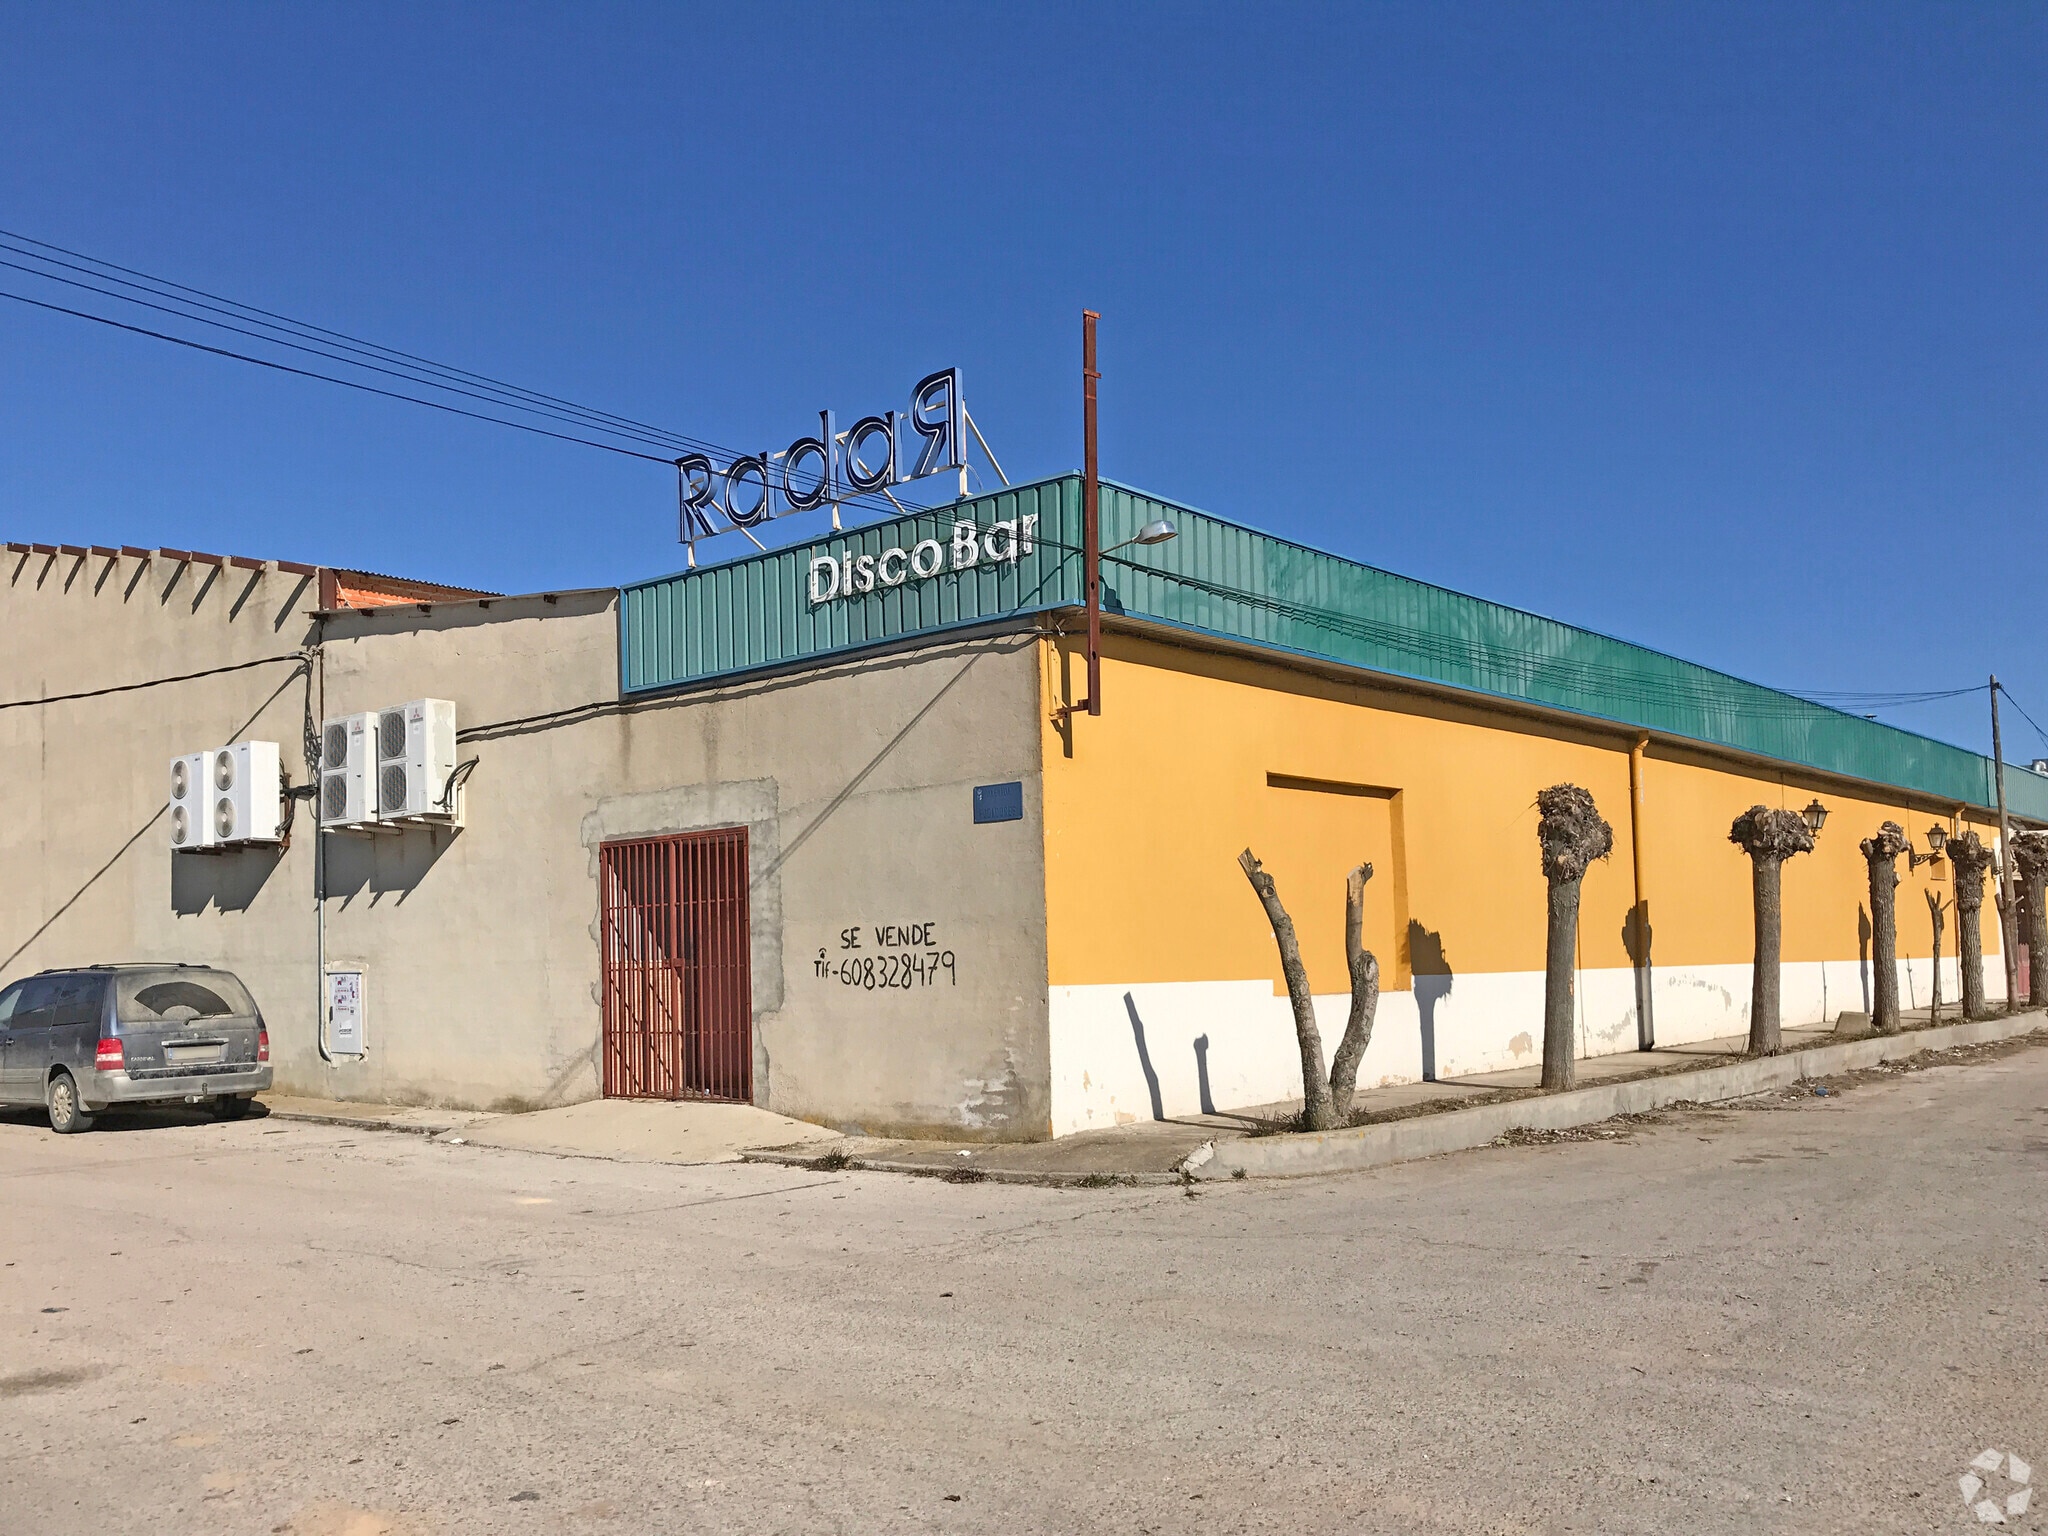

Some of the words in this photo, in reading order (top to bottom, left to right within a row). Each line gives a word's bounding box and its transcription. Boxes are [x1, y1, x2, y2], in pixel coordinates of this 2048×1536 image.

[809, 539, 943, 604] Disco
[950, 513, 1038, 564] Bar
[840, 926, 862, 949] SE
[875, 921, 937, 947] VENDE
